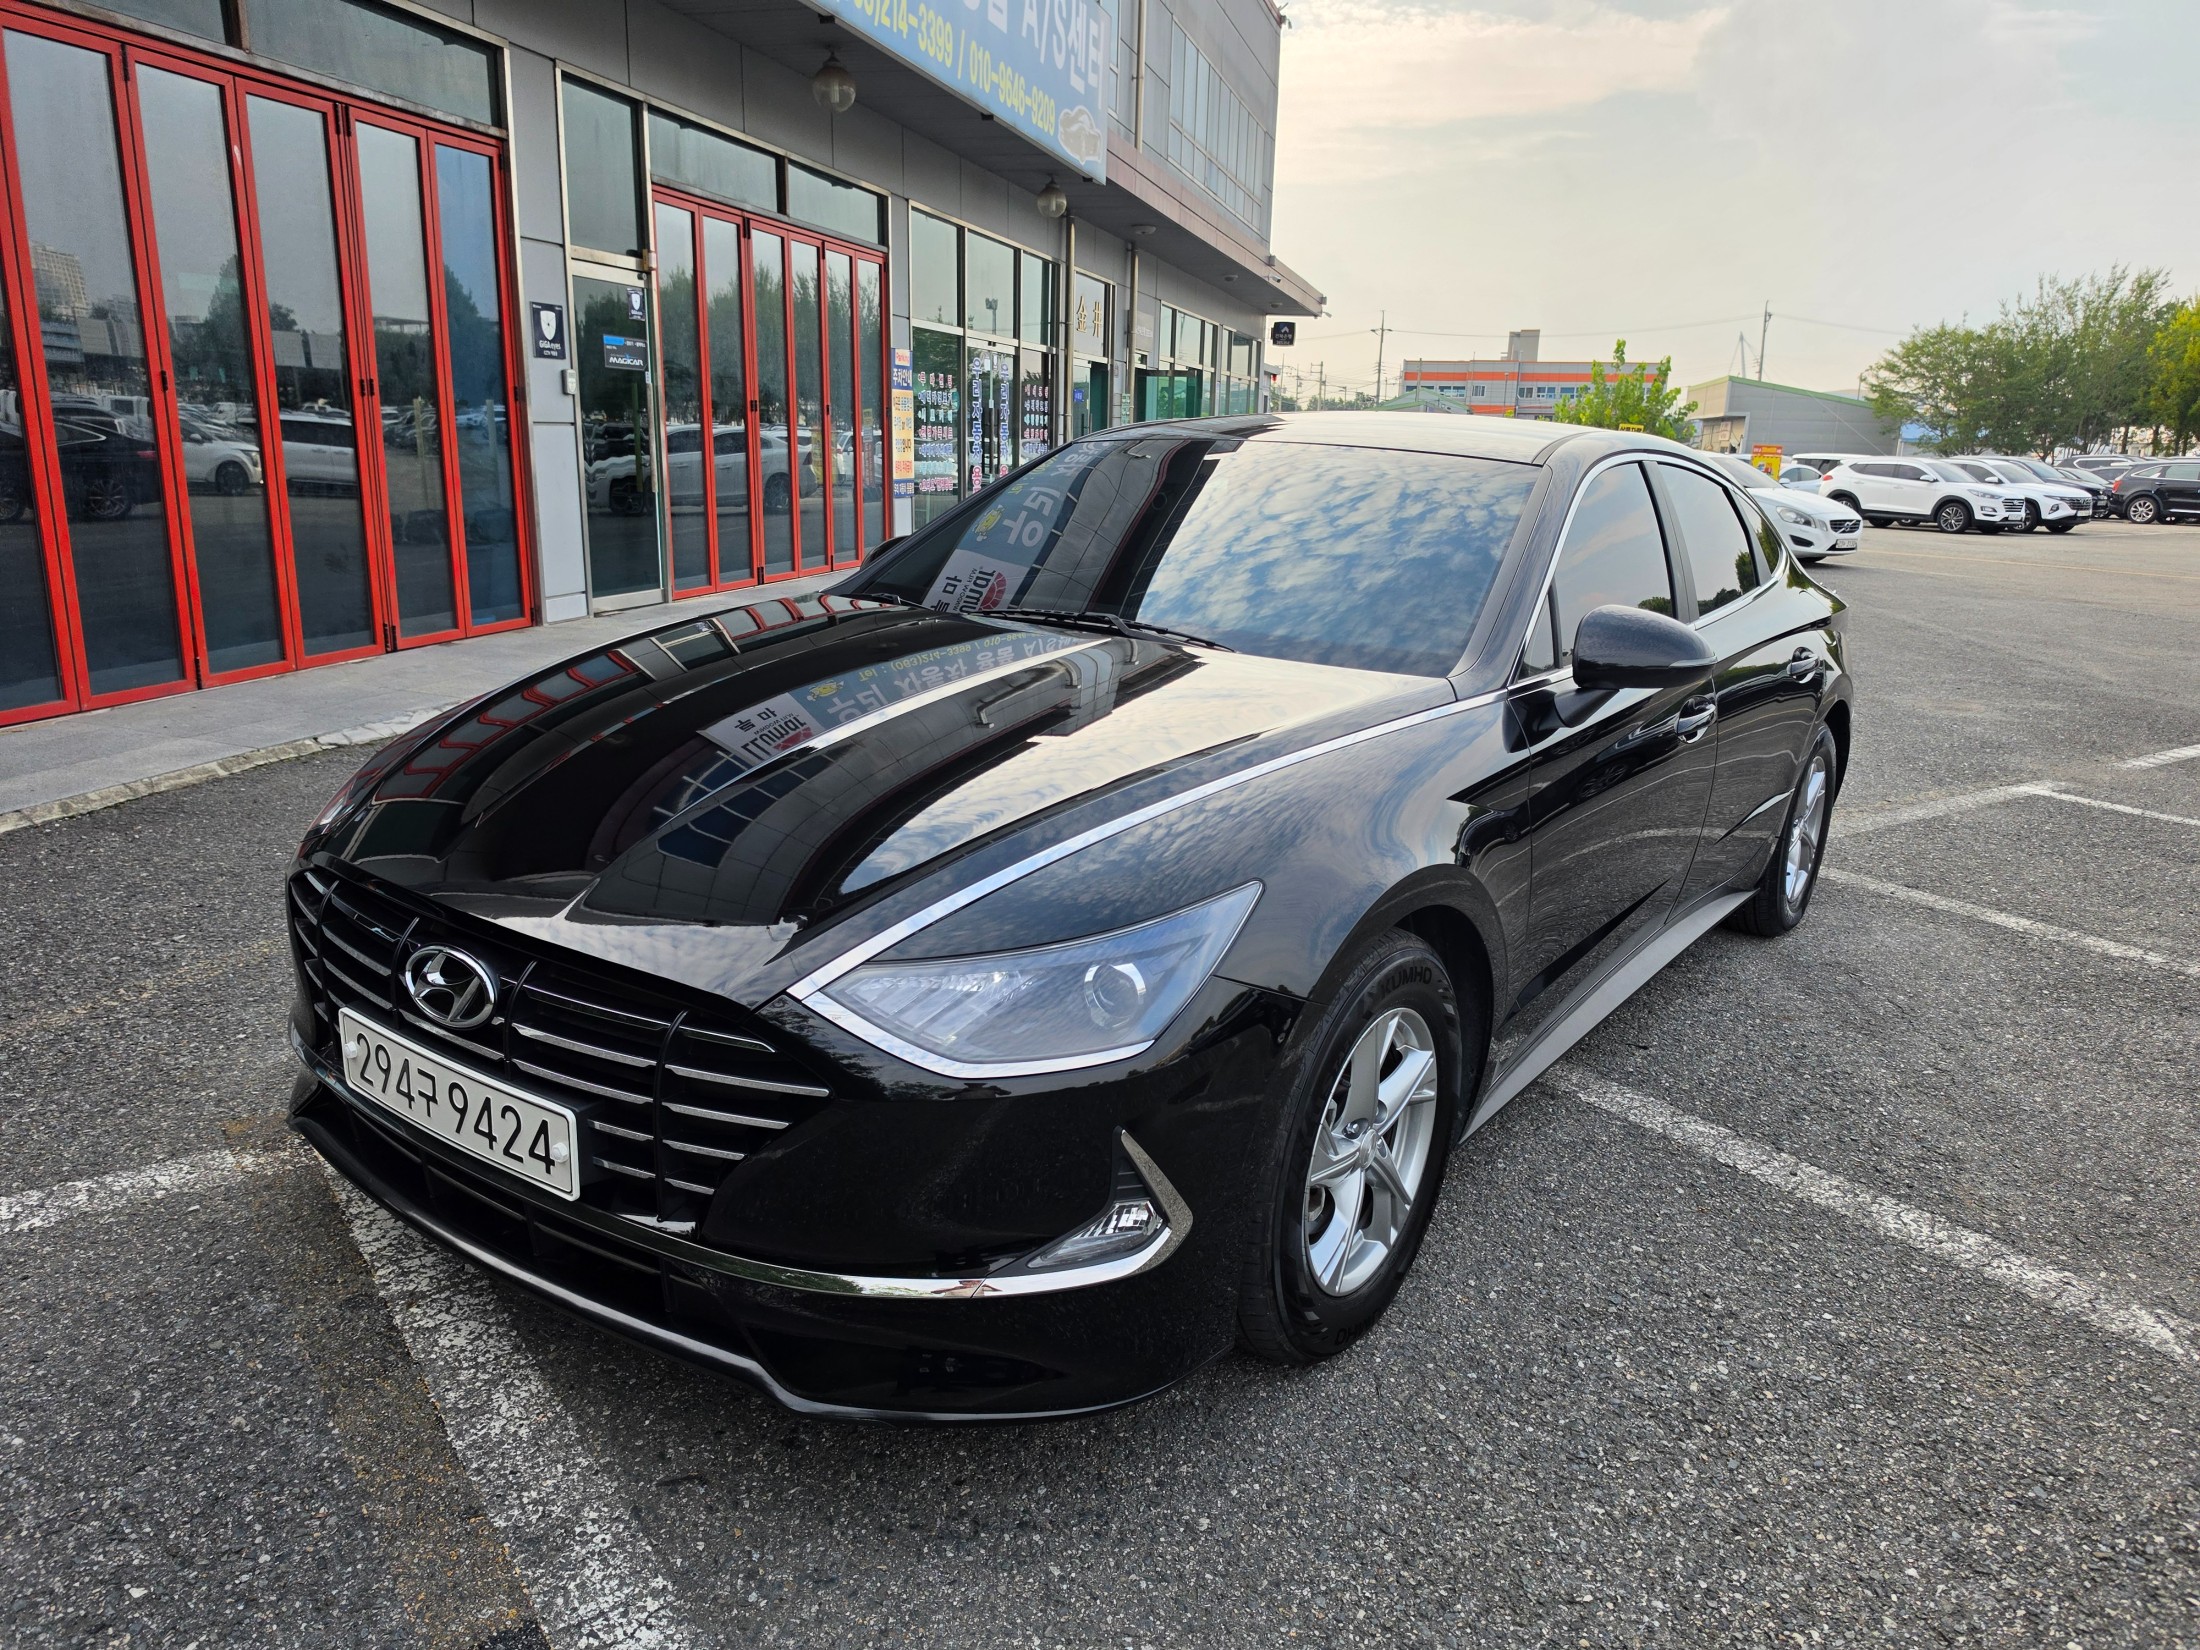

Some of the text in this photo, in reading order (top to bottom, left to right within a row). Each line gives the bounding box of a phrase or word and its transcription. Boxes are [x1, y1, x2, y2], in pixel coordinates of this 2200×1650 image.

[854, 0, 953, 69] )214-3399
[970, 40, 1055, 137] 010-9646-9209
[1076, 295, 1102, 338] 金井
[609, 357, 643, 366] MAGICAR
[893, 368, 912, 387] 주차안내
[1380, 966, 1432, 999] KUMHO
[356, 1032, 555, 1174] 294구 9424
